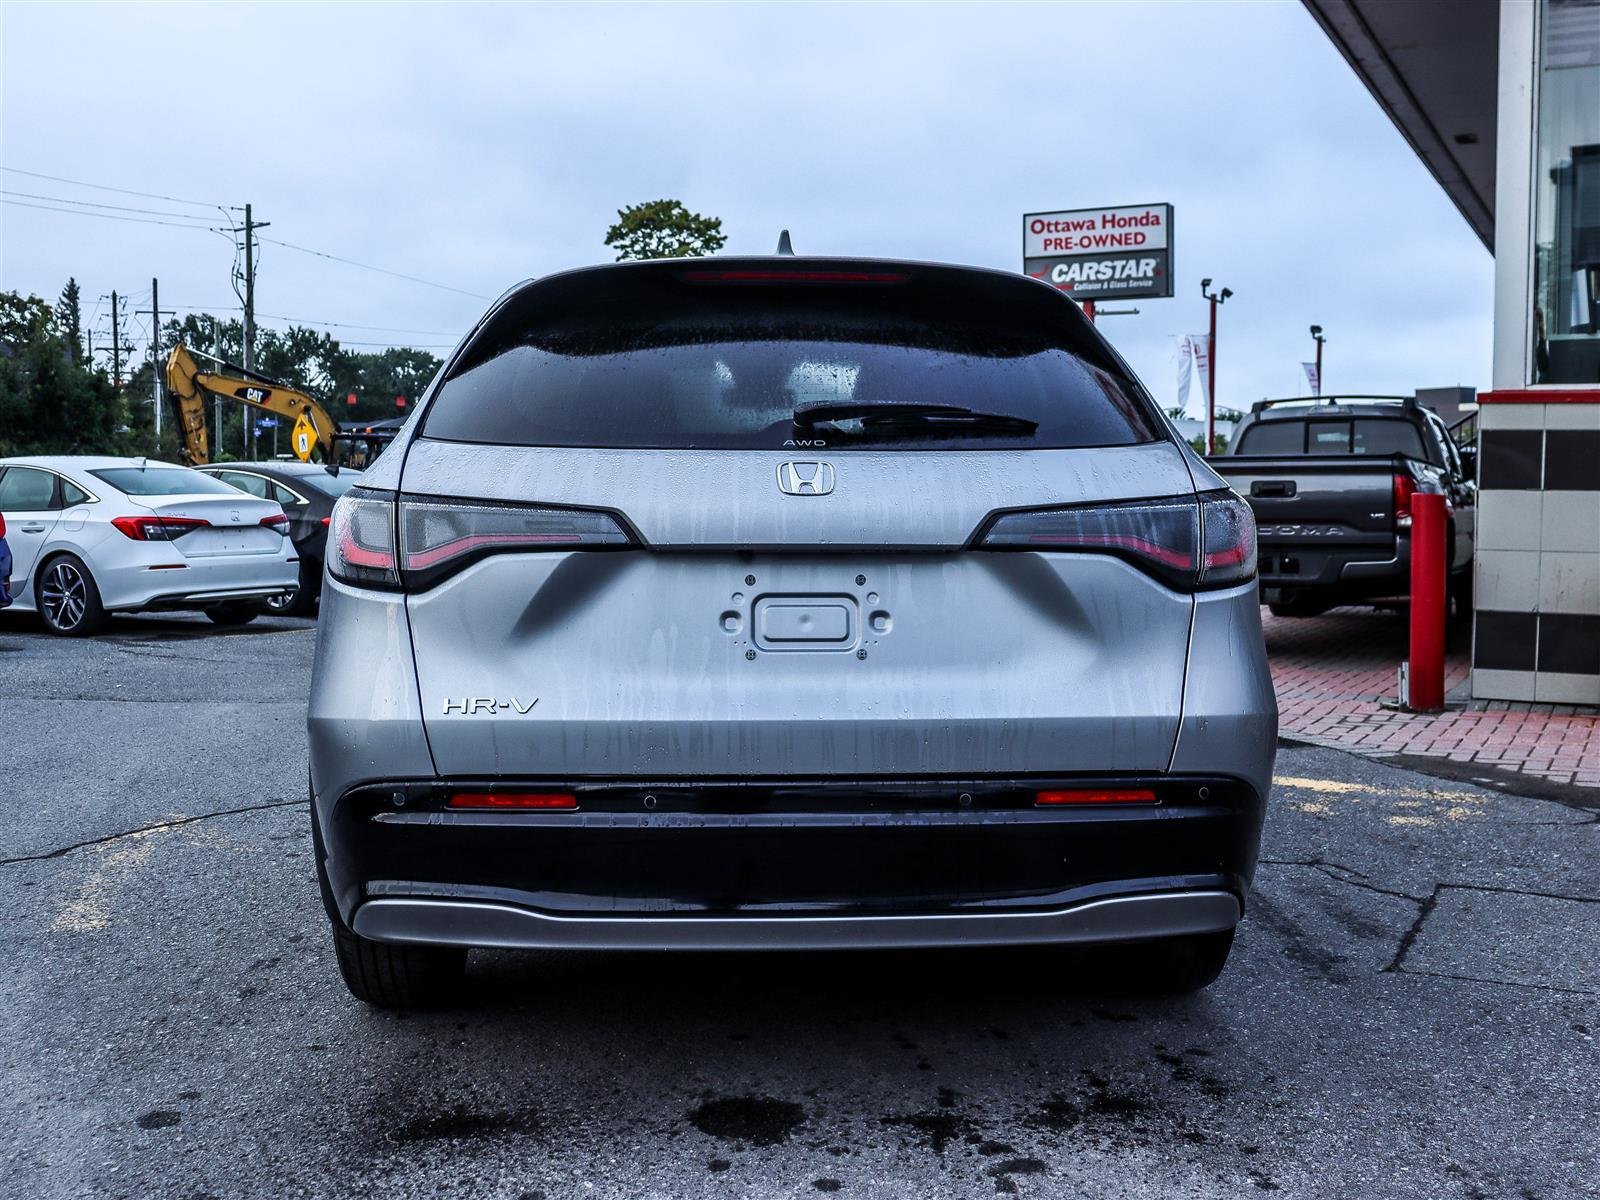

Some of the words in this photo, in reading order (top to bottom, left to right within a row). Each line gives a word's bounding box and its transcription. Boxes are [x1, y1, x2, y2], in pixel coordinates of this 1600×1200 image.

[1030, 216, 1096, 235] Ottawa
[1102, 211, 1161, 229] Honda
[1043, 232, 1146, 251] PRE-OWNED
[1051, 258, 1156, 283] CARSTAR
[1073, 281, 1102, 291] Collision
[1128, 279, 1153, 288] Service
[246, 387, 264, 403] CAT
[782, 439, 827, 447] AWD
[442, 697, 539, 714] HR-V
